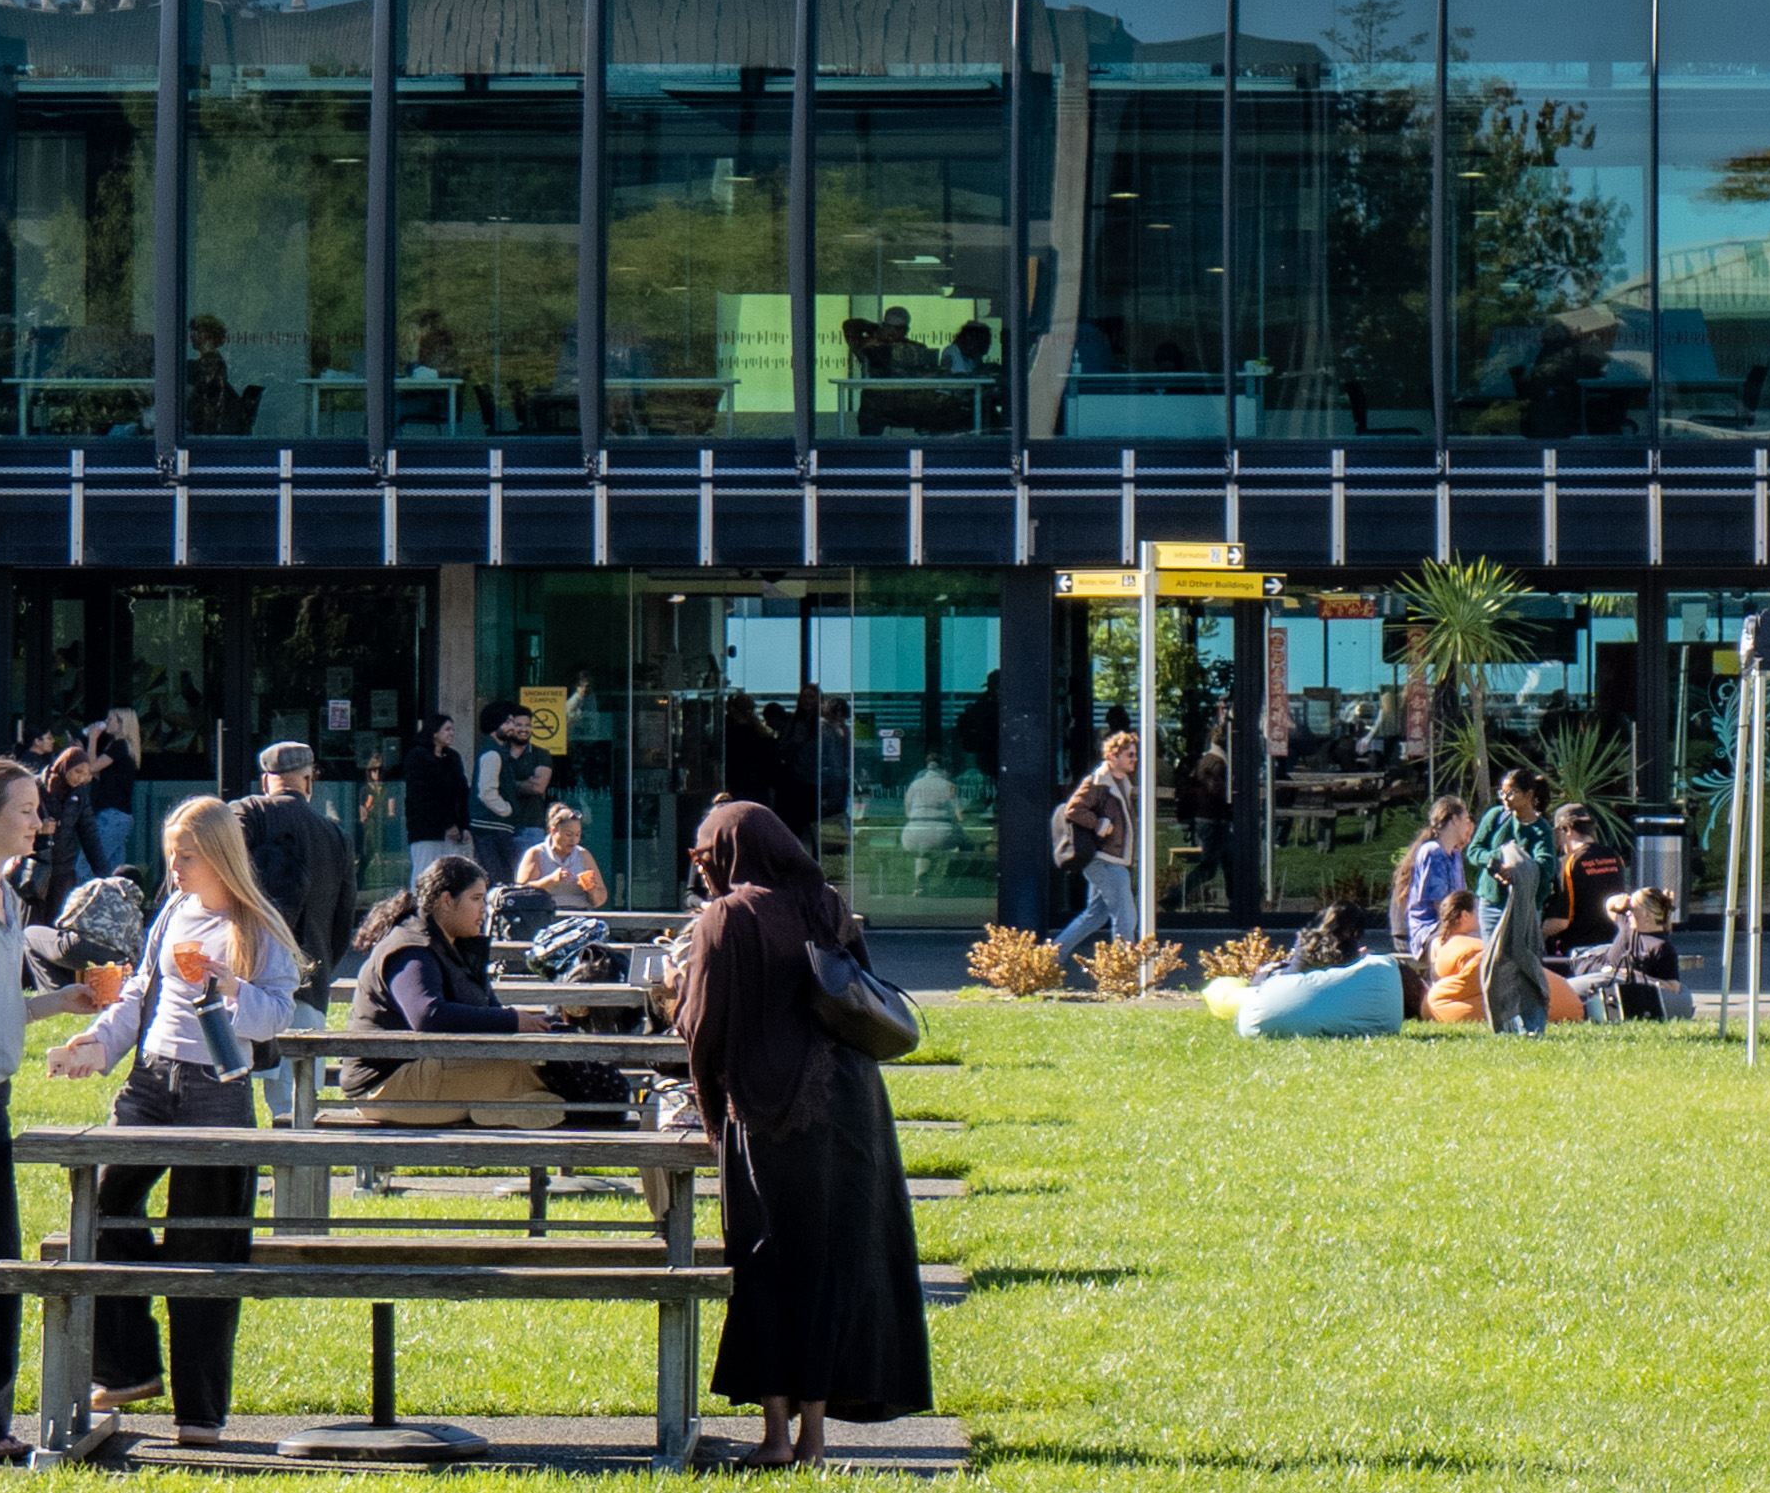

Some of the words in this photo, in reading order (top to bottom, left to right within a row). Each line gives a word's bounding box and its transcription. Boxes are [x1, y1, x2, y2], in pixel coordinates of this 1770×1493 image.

[1176, 580, 1190, 588] All
[1193, 580, 1213, 589] Other
[1215, 581, 1254, 590] Buildings
